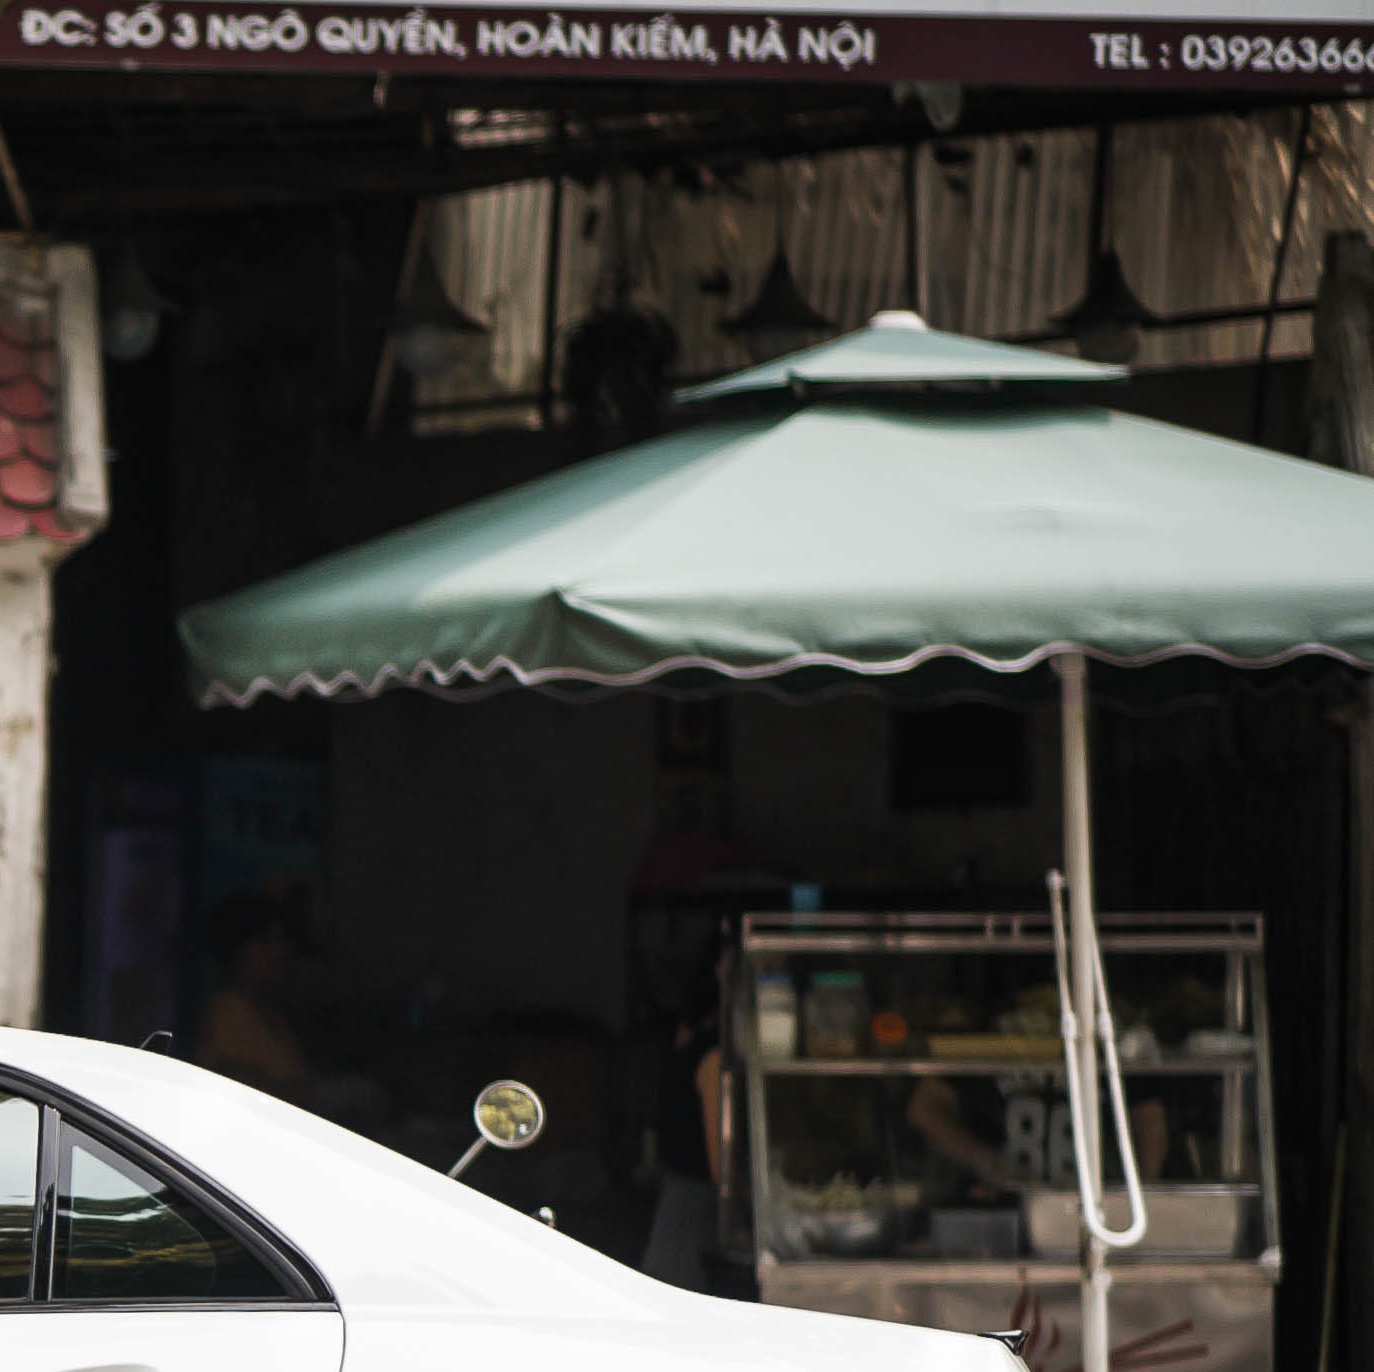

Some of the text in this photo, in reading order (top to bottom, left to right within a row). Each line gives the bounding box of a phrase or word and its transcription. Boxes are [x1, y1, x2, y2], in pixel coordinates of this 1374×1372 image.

[171, 12, 198, 49] 3
[206, 8, 308, 51] NGÔ
[475, 13, 602, 59] HOÀN
[727, 16, 789, 63] HÀ
[798, 20, 877, 71] NỘI
[1089, 32, 1150, 69] TEL
